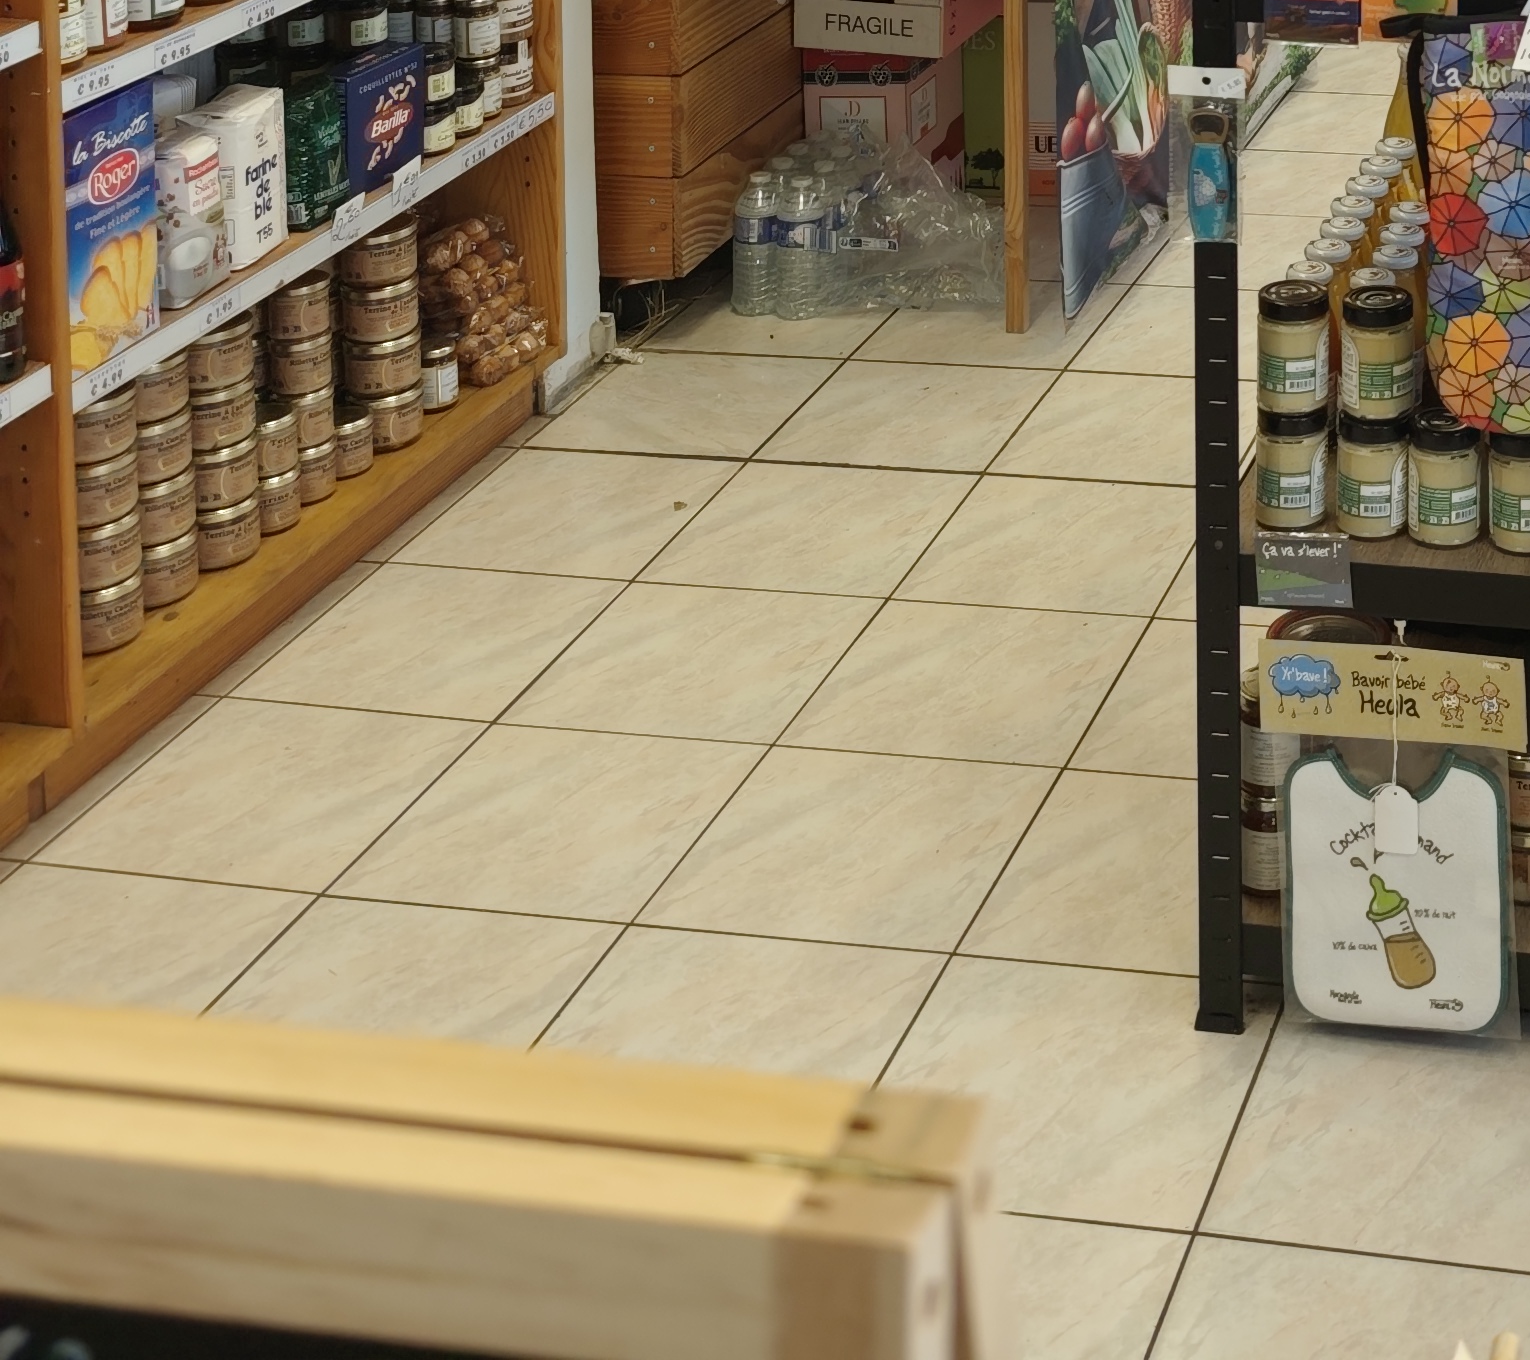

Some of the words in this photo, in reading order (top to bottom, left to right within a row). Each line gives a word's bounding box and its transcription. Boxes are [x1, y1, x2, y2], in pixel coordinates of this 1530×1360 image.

[825, 12, 914, 39] FRAGILE
[1432, 63, 1462, 89] La
[371, 107, 411, 138] Barilla
[72, 137, 89, 166] la
[92, 111, 150, 157] Biscotte
[93, 158, 136, 199] Roger
[245, 152, 278, 187] farine
[256, 178, 271, 198] de
[254, 191, 273, 221] blé
[257, 221, 274, 244] T55
[1262, 542, 1279, 560] Ça
[1281, 546, 1296, 558] va
[1297, 543, 1331, 559] s'lever
[1350, 670, 1391, 689] Bavoir
[1395, 671, 1427, 691] bébé
[1358, 689, 1422, 720] Heula
